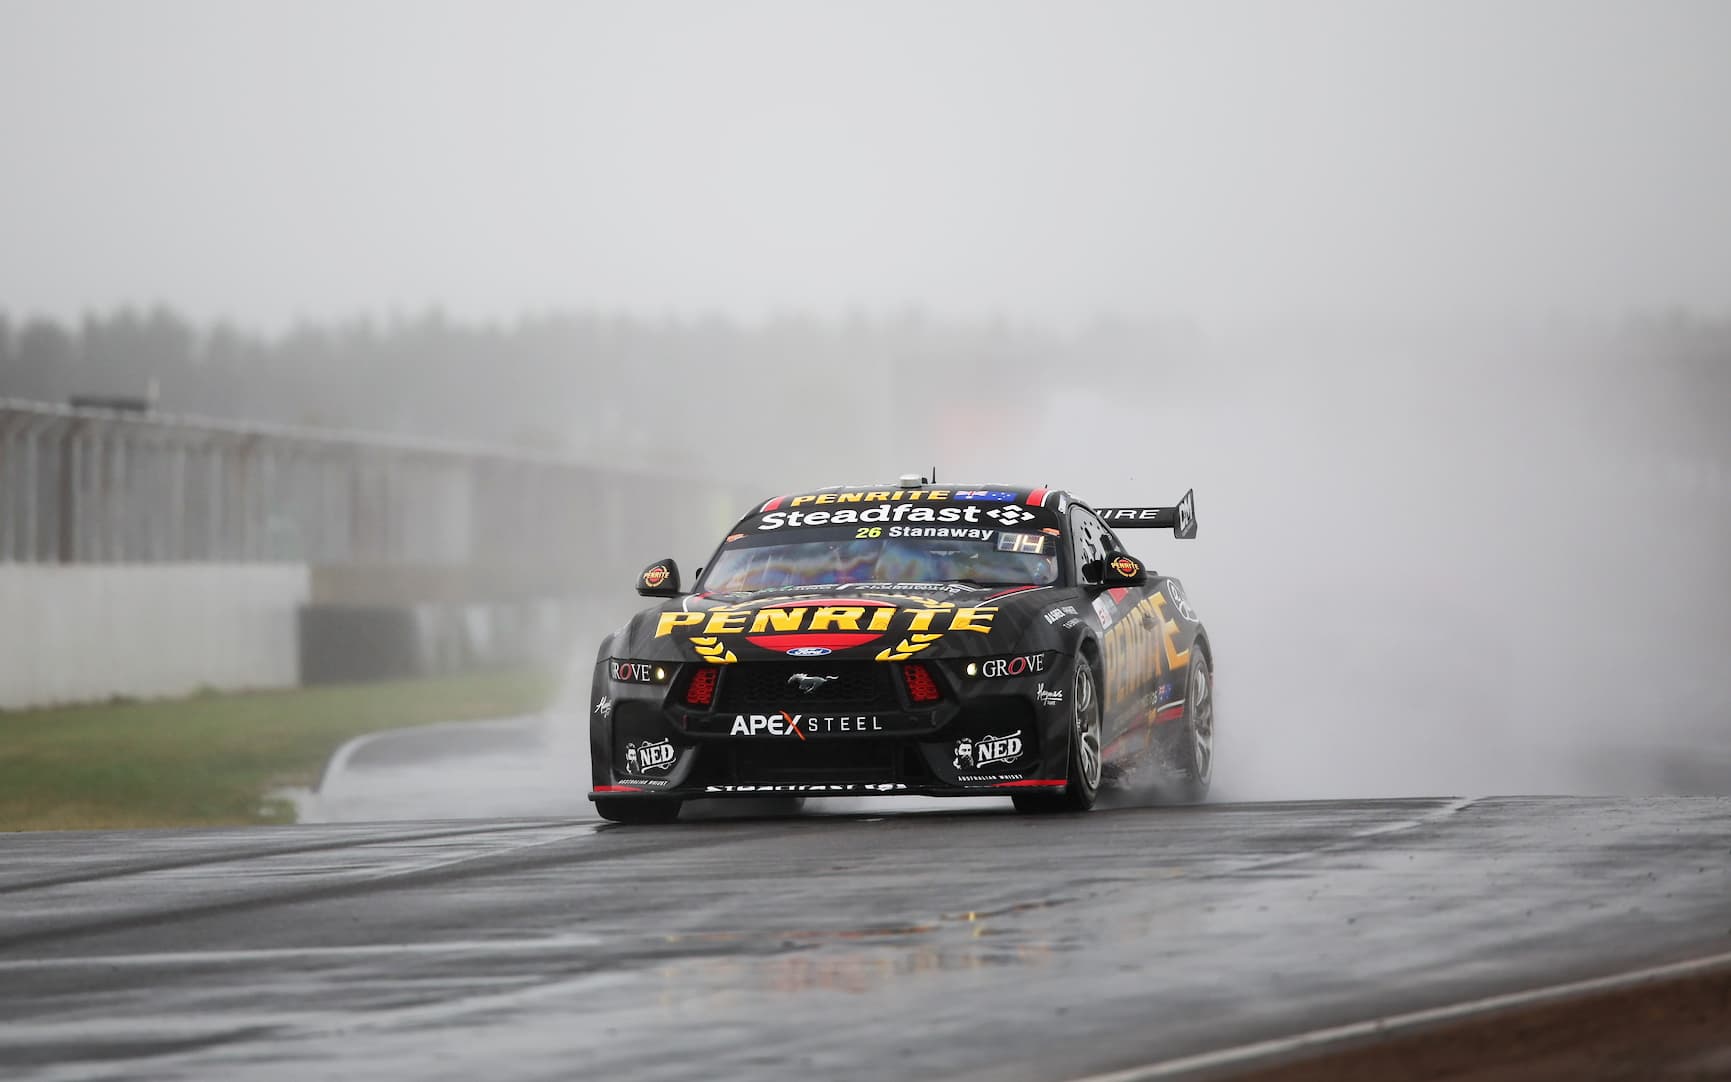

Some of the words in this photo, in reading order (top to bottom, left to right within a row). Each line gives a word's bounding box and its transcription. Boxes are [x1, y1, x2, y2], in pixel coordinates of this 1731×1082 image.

[791, 490, 950, 507] PENRITE
[758, 504, 981, 530] Steadfast
[855, 527, 882, 539] 26
[888, 526, 994, 541] Stanaway
[654, 605, 999, 638] PENRITE
[982, 654, 1045, 677] GROVE
[730, 710, 806, 740] APEX
[808, 716, 882, 731] STEEL
[640, 744, 674, 767] NED
[978, 738, 1022, 762] NED
